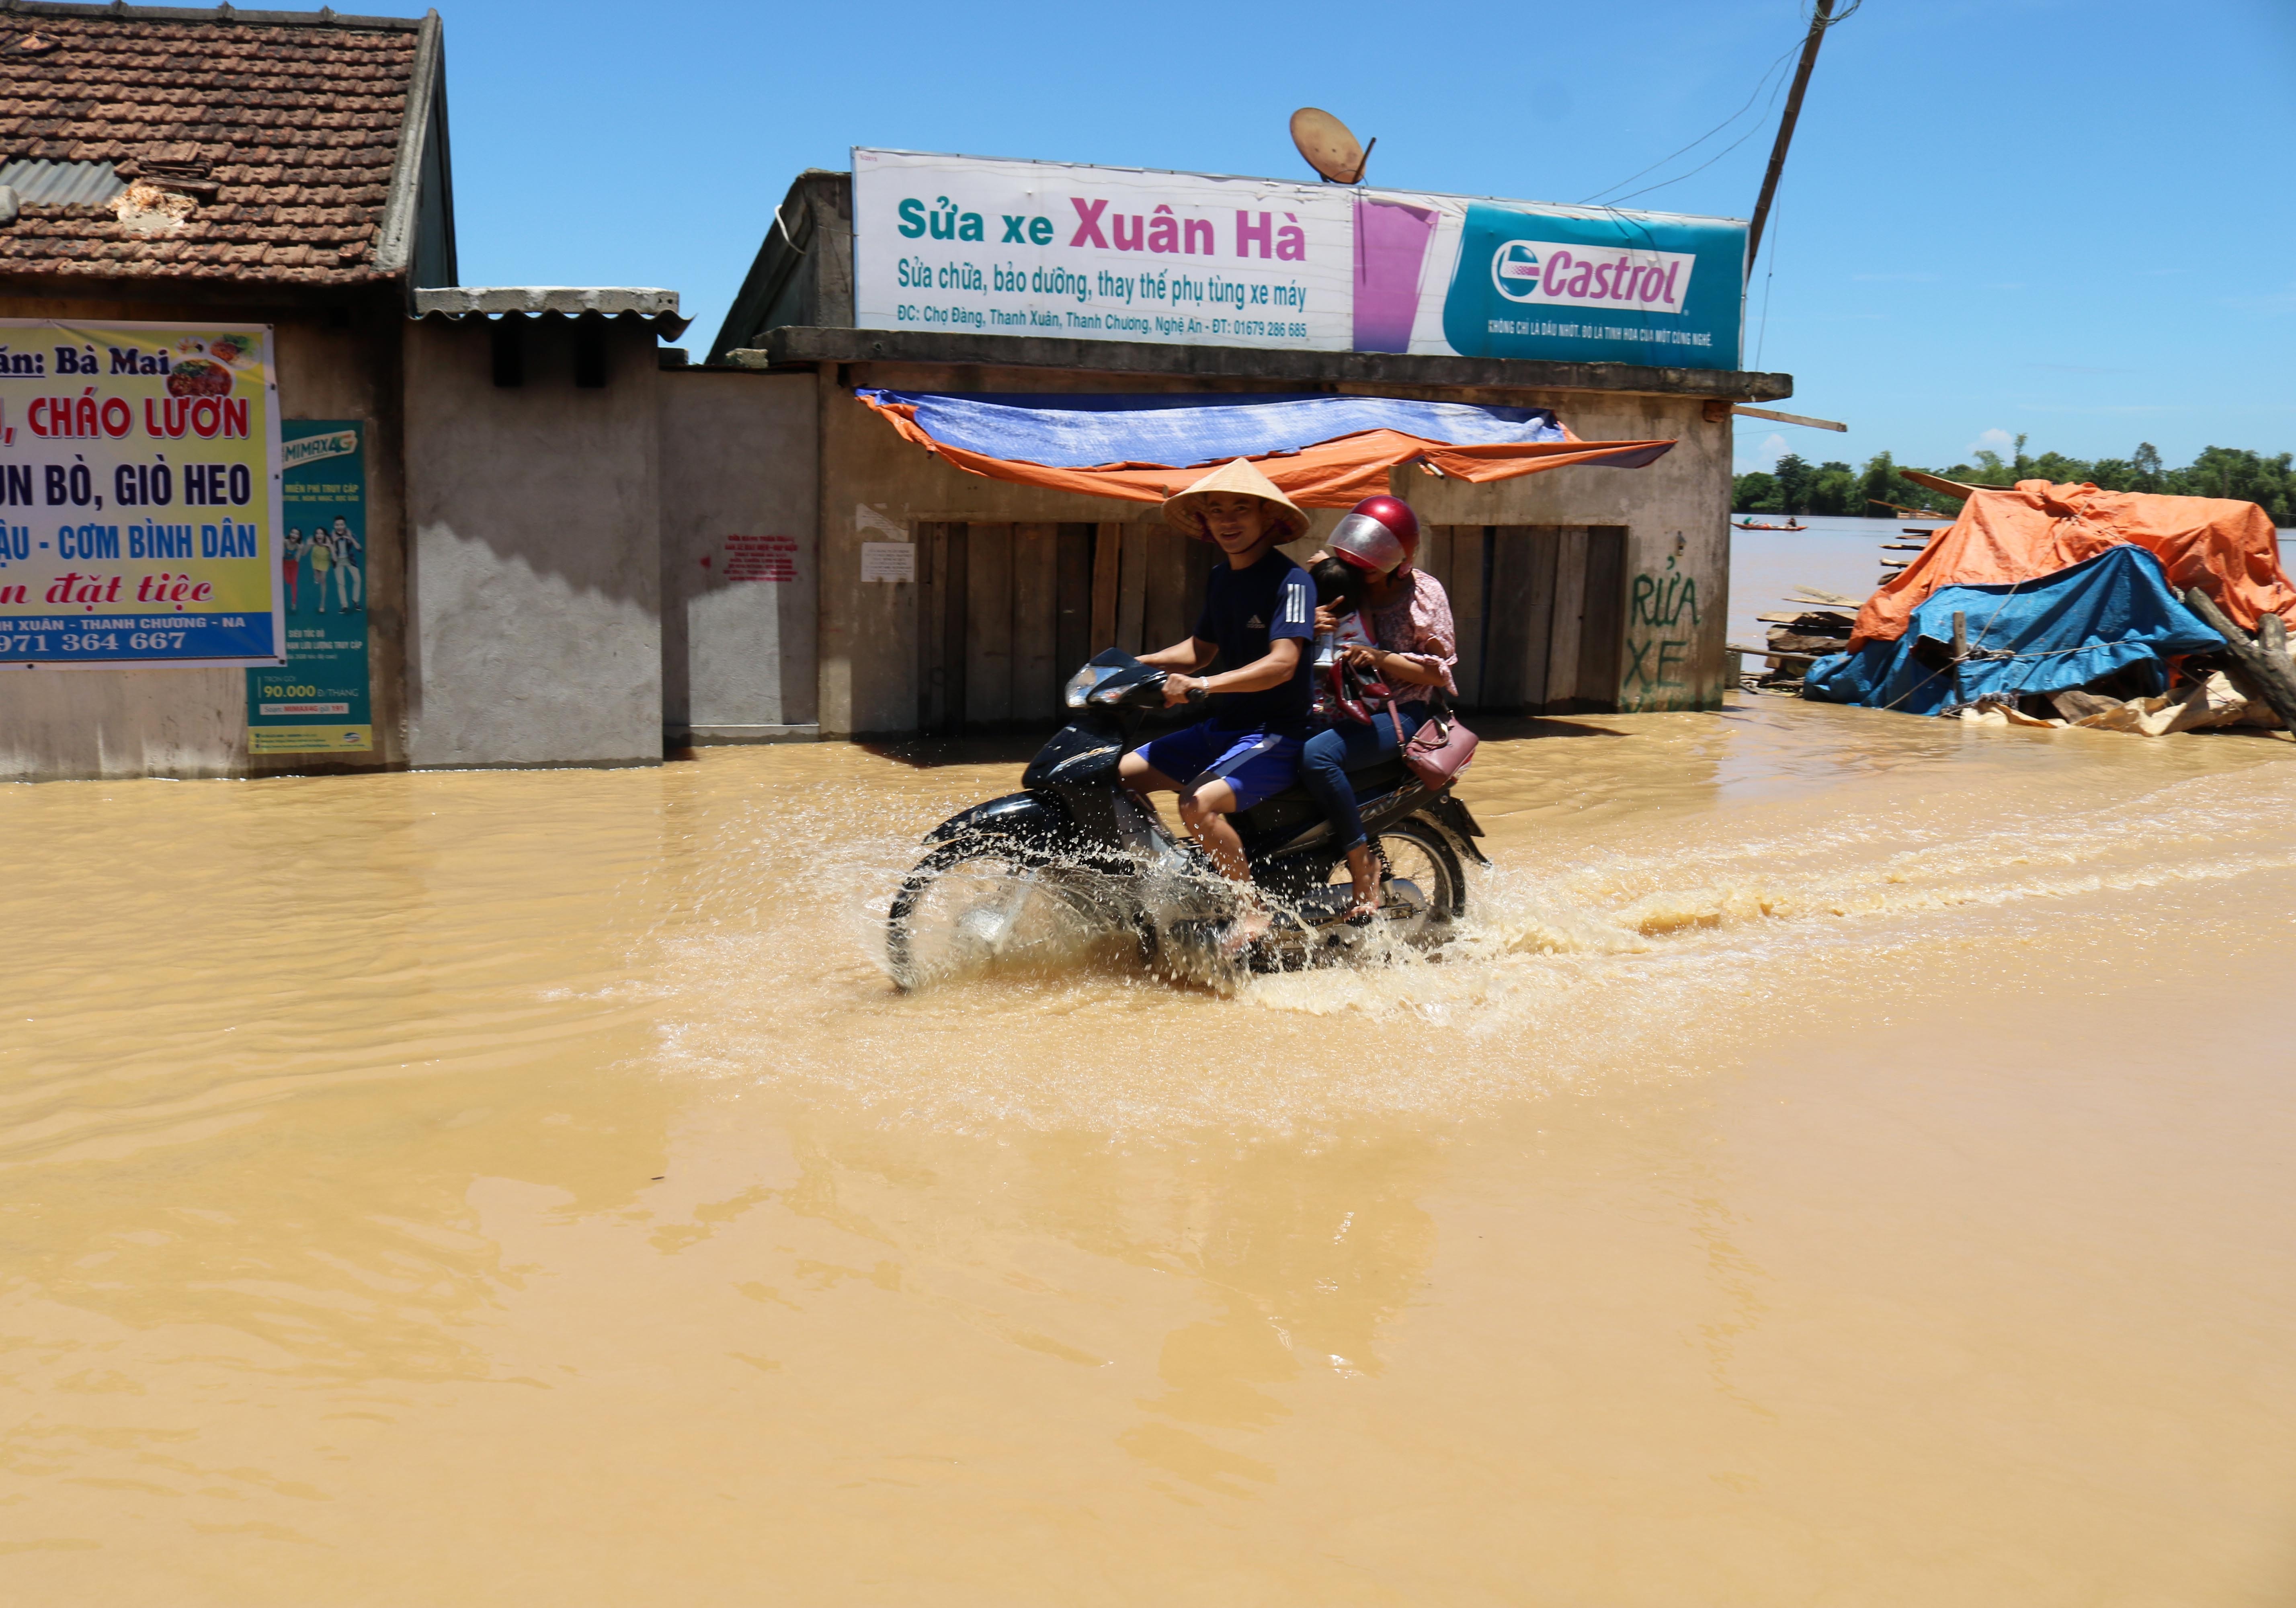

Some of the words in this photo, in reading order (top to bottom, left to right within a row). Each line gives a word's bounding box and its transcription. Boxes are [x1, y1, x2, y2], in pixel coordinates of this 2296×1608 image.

[898, 196, 984, 242] Sửa
[1001, 215, 1054, 246] xe
[1070, 197, 1214, 256] Xuân
[1236, 210, 1306, 261] Hà
[898, 256, 932, 288] Sửa
[939, 261, 987, 295] chữa,
[994, 261, 1027, 292] bảo
[1033, 266, 1092, 302] dưỡng,
[1098, 270, 1134, 304] thay
[1140, 269, 1168, 299] thế
[1172, 275, 1203, 306] phụ
[1209, 275, 1244, 310] tùng
[1250, 285, 1268, 304] xe
[1274, 279, 1306, 313] máy
[1543, 250, 1680, 304] Castrol
[898, 304, 919, 321] ĐC:
[924, 306, 948, 325] Chợ
[951, 306, 985, 328] Đàng,
[990, 309, 1026, 325] Thanh
[1029, 311, 1062, 329] Xuân,
[1066, 312, 1101, 328] Thanh
[1105, 314, 1151, 334] Chương,
[1155, 316, 1184, 335] Nghệ
[1187, 320, 1202, 333] An
[1212, 319, 1231, 334] ĐT:
[1234, 320, 1264, 336] 01679
[1267, 322, 1285, 336] 286
[1289, 323, 1306, 337] 685
[55, 345, 99, 375] Bà
[108, 347, 170, 375] Mai
[28, 386, 133, 439] CHÁO
[145, 395, 249, 439] LƯƠN
[285, 434, 353, 461] MIMAX4G
[0, 465, 33, 506] N
[45, 454, 102, 510] BÒ,
[115, 454, 172, 506] GIÒ
[184, 464, 251, 506] HEO
[59, 523, 119, 560] CƠM
[129, 518, 193, 558] BÌNH
[201, 518, 256, 558] DÂN
[45, 572, 123, 611] đặt
[138, 573, 213, 611] tiệc
[1631, 556, 1701, 627] RỬA
[18, 618, 65, 630] XUÂN
[81, 619, 135, 630] THANH
[141, 617, 206, 629] CHƯƠNG
[222, 617, 246, 628] NA
[62, 633, 119, 651] 364
[130, 632, 186, 650] 667
[1624, 638, 1688, 693] XE
[264, 685, 316, 698] 90.000
